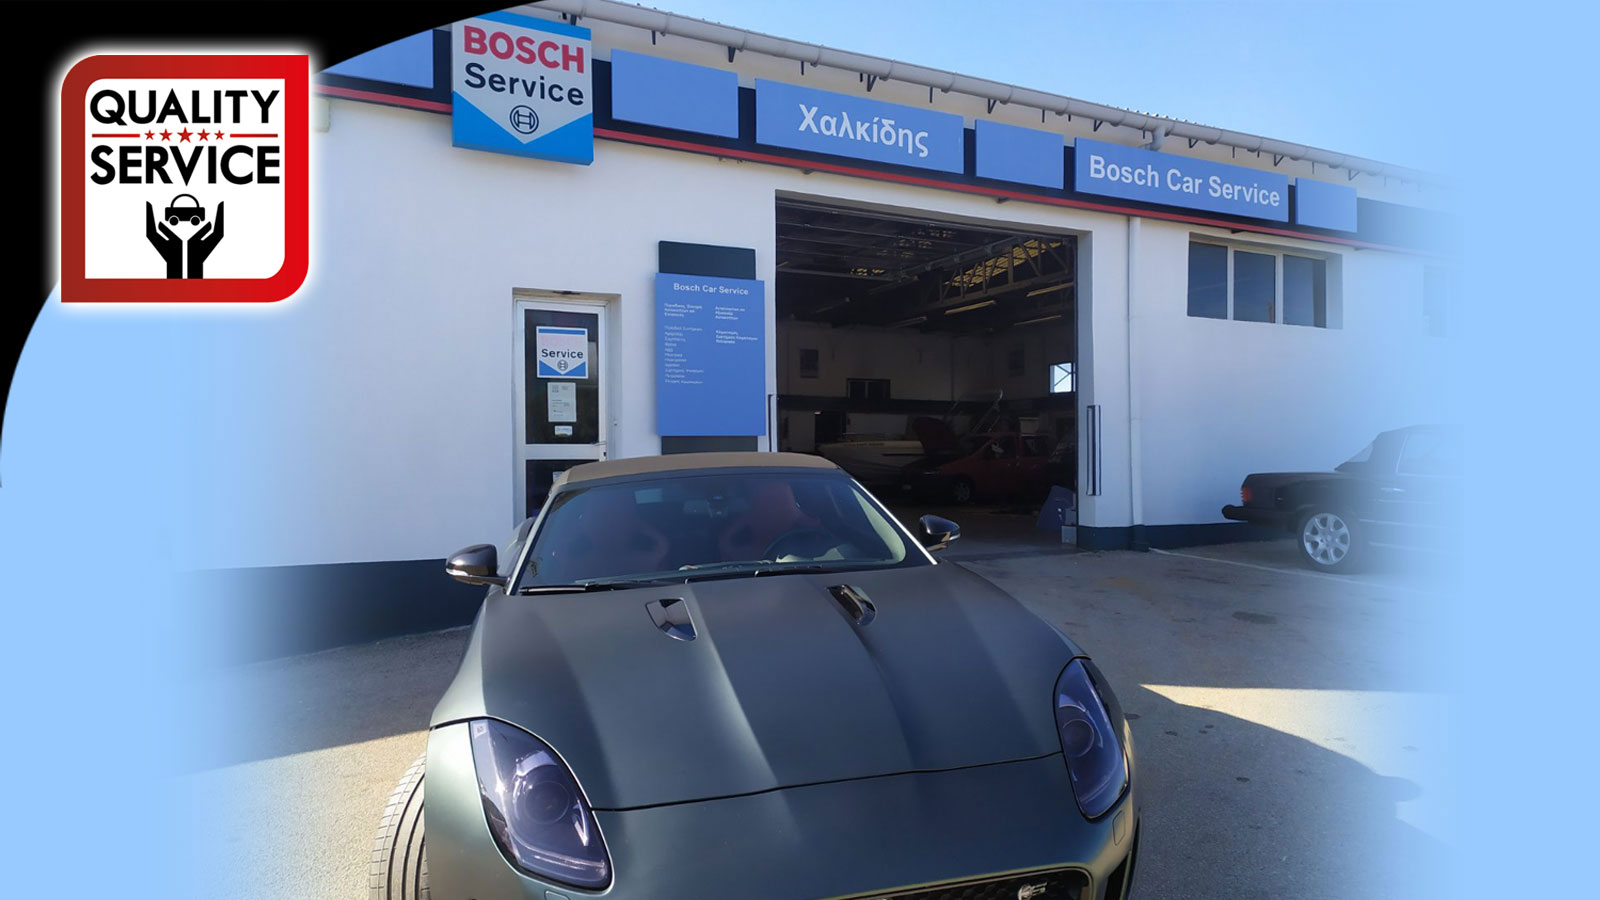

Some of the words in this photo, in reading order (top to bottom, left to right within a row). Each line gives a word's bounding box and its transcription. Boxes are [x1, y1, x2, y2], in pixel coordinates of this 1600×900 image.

[464, 25, 584, 74] BOSCH
[465, 63, 584, 106] Service
[799, 104, 929, 158] Χαλκίδης
[1090, 155, 1159, 188] Bosch
[1166, 169, 1202, 194] Car
[1208, 176, 1280, 207] Service
[673, 282, 700, 292] Bosch
[702, 285, 717, 293] Car
[718, 286, 749, 296] Service
[541, 348, 584, 359] Service
